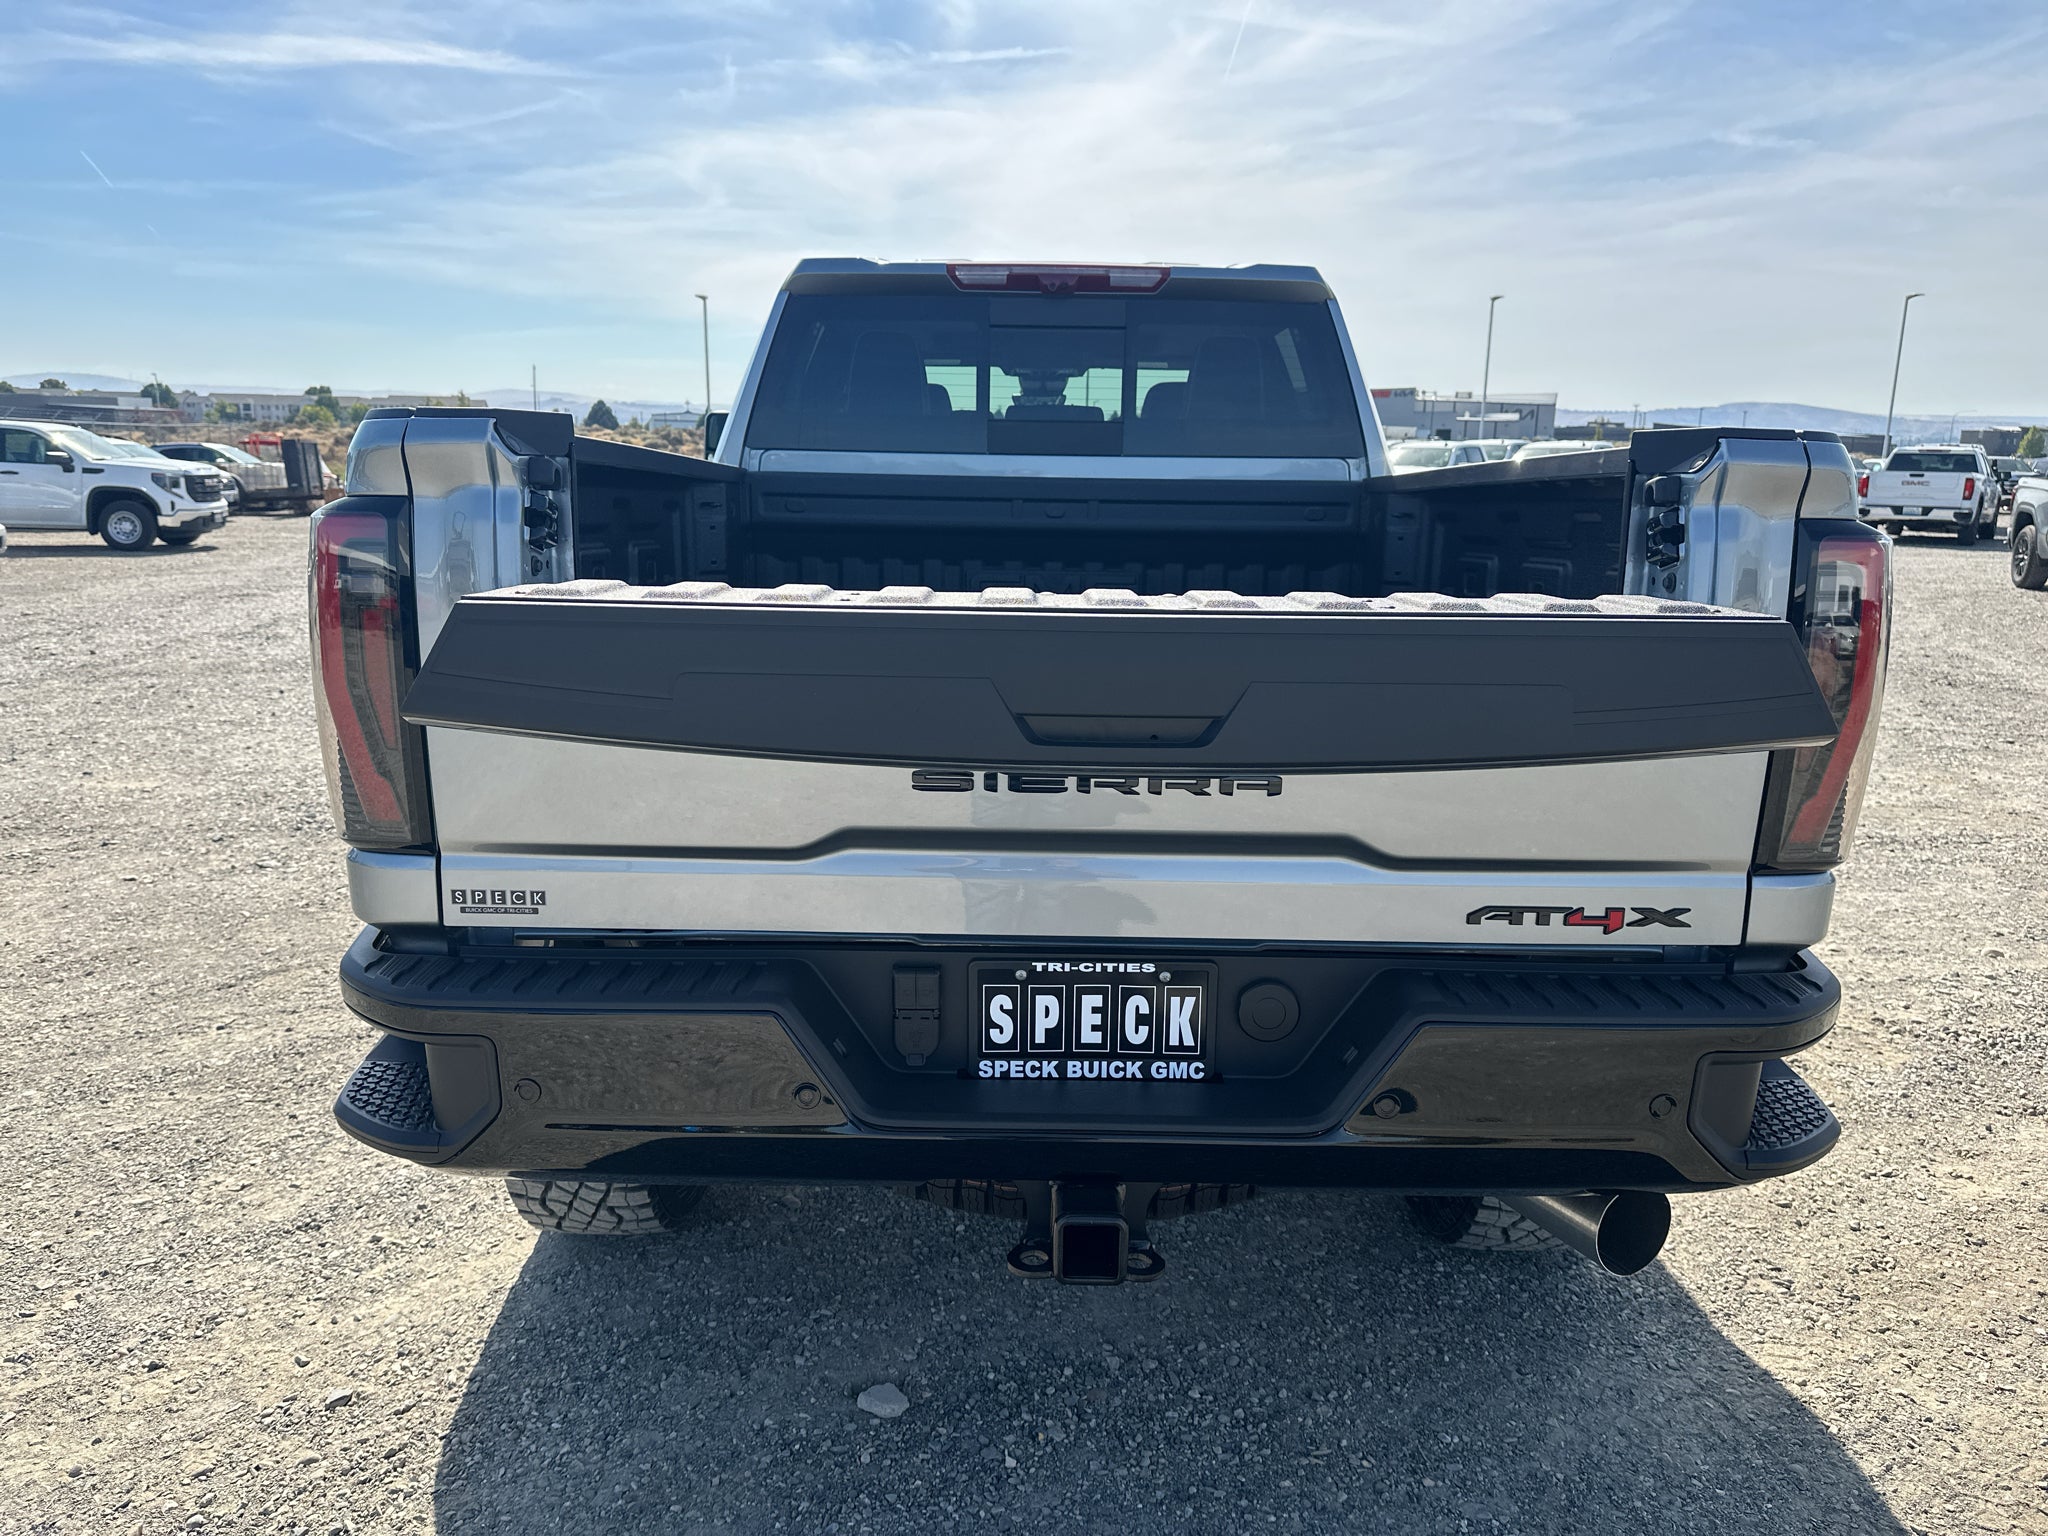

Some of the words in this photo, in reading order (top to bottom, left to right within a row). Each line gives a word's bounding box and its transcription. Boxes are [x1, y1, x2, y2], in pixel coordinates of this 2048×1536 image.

[911, 769, 1283, 796] SIERRA
[455, 891, 543, 904] SPECK
[1465, 905, 1693, 935] AT4X
[1031, 962, 1156, 973] TRI-CITIES
[988, 993, 1197, 1047] SPECK
[978, 1060, 1060, 1079] SPECK
[1066, 1060, 1144, 1079] BUICK
[1150, 1060, 1206, 1080] GMC
